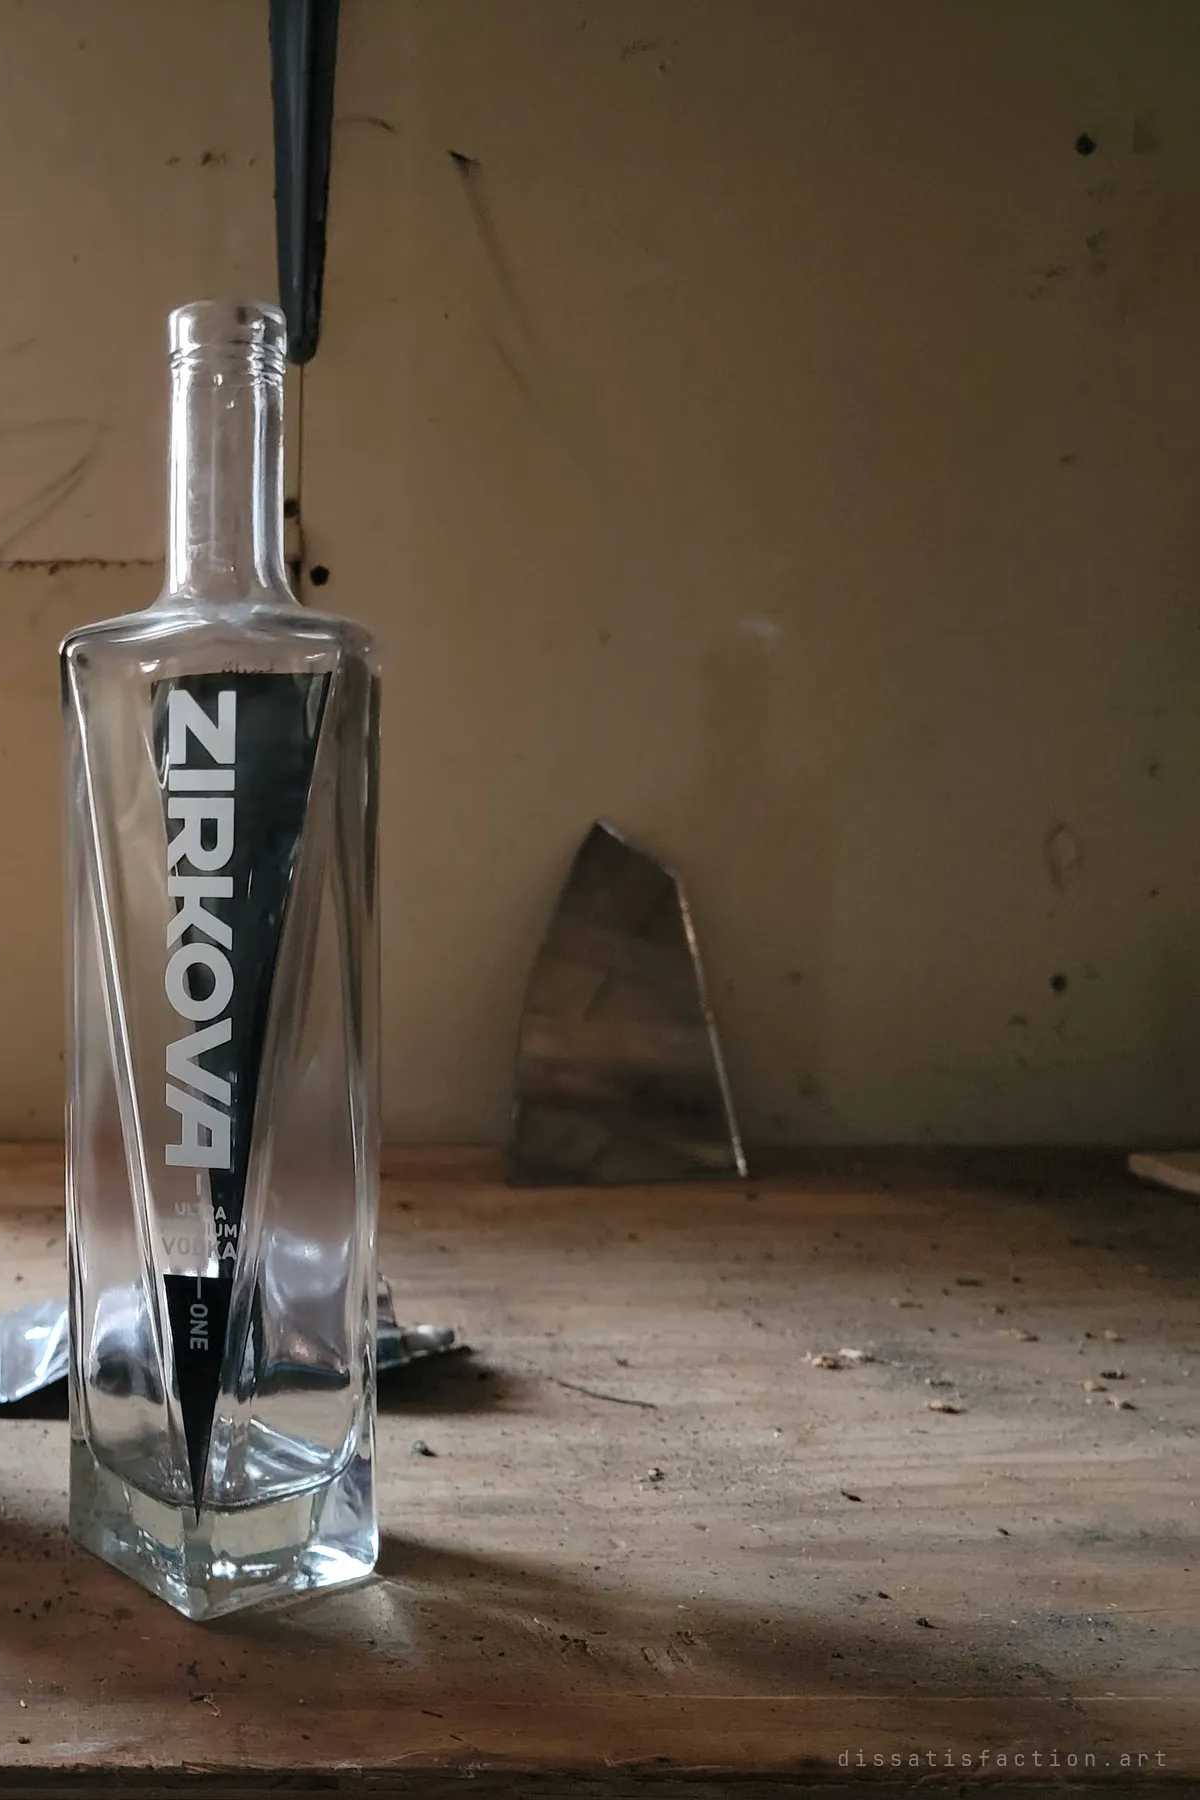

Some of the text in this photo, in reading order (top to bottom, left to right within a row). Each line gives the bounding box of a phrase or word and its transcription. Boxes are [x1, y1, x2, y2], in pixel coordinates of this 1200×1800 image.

[165, 690, 236, 1169] ZIRKOVA
[161, 1235, 237, 1260] VODKA
[190, 1304, 208, 1350] ONE
